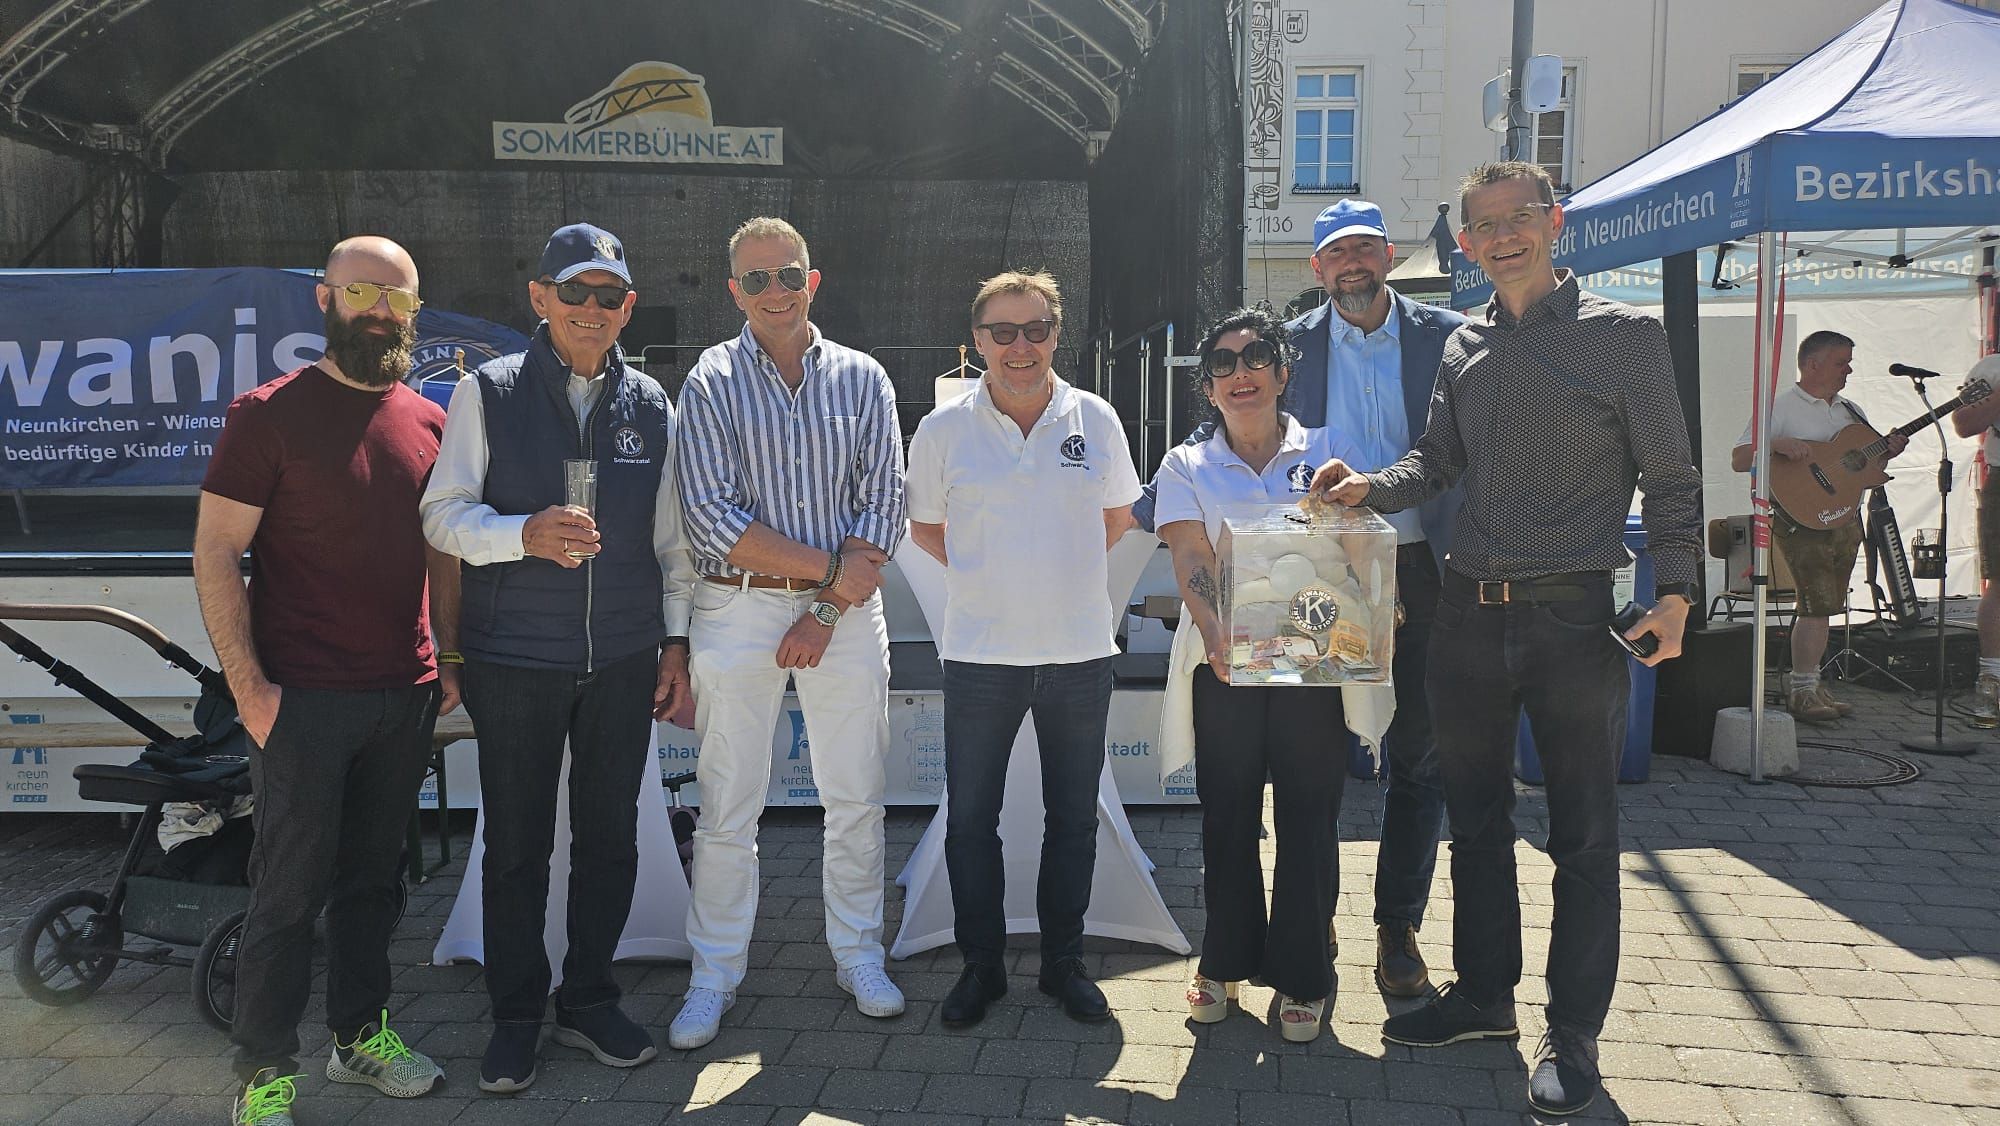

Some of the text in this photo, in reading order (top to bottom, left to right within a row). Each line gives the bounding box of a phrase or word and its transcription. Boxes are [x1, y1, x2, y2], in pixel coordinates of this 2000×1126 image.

[501, 127, 775, 158] SOMMERBÜHNE.AT
[1796, 158, 2000, 201] Bezirksh
[1255, 215, 1293, 233] 1136
[1551, 225, 1577, 259] adt
[1584, 190, 1715, 249] Neunkirchen
[5, 417, 140, 434] Neunkirchen
[163, 414, 227, 430] Wiener
[4, 440, 213, 463] bedürftige Kinder in
[1298, 590, 1331, 602] KIWANIS
[1292, 605, 1336, 631] INTERNATIONAL
[658, 743, 700, 759] shau
[17, 770, 49, 779] neun
[793, 764, 815, 774] neu
[6, 781, 49, 791] kirchen
[781, 776, 815, 785] kirche
